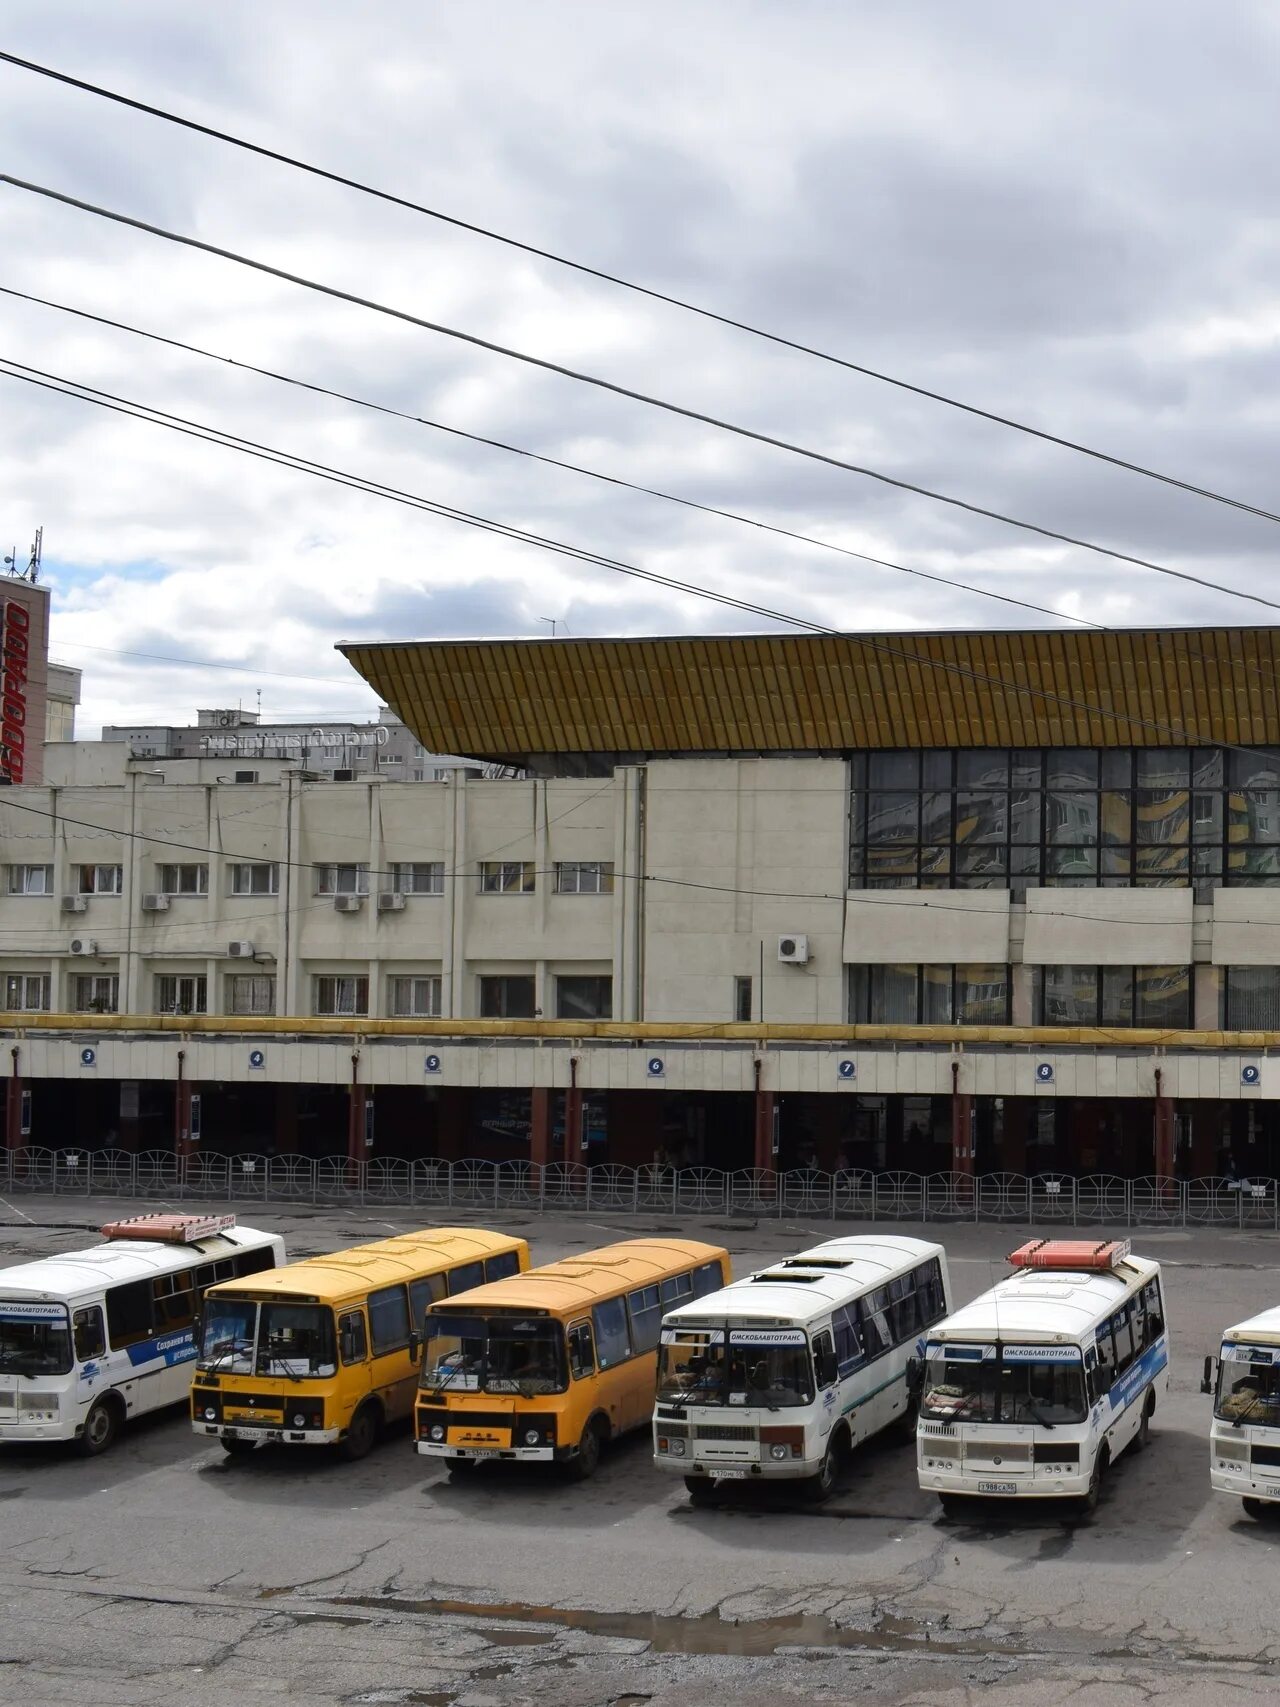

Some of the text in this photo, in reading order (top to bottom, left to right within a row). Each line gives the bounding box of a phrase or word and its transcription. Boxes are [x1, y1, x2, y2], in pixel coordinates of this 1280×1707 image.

[85, 1052, 92, 1060] 3
[253, 1054, 260, 1062] 4
[430, 1058, 437, 1067] 5
[652, 1061, 660, 1070] 6
[844, 1063, 851, 1073] 7
[1041, 1067, 1049, 1076] 8
[1247, 1069, 1255, 1078] 9
[731, 1334, 801, 1342] ОМСКОБЛАВТОТРАНС
[1004, 1349, 1077, 1357] ОМСКОБЛАВТОТРАНС
